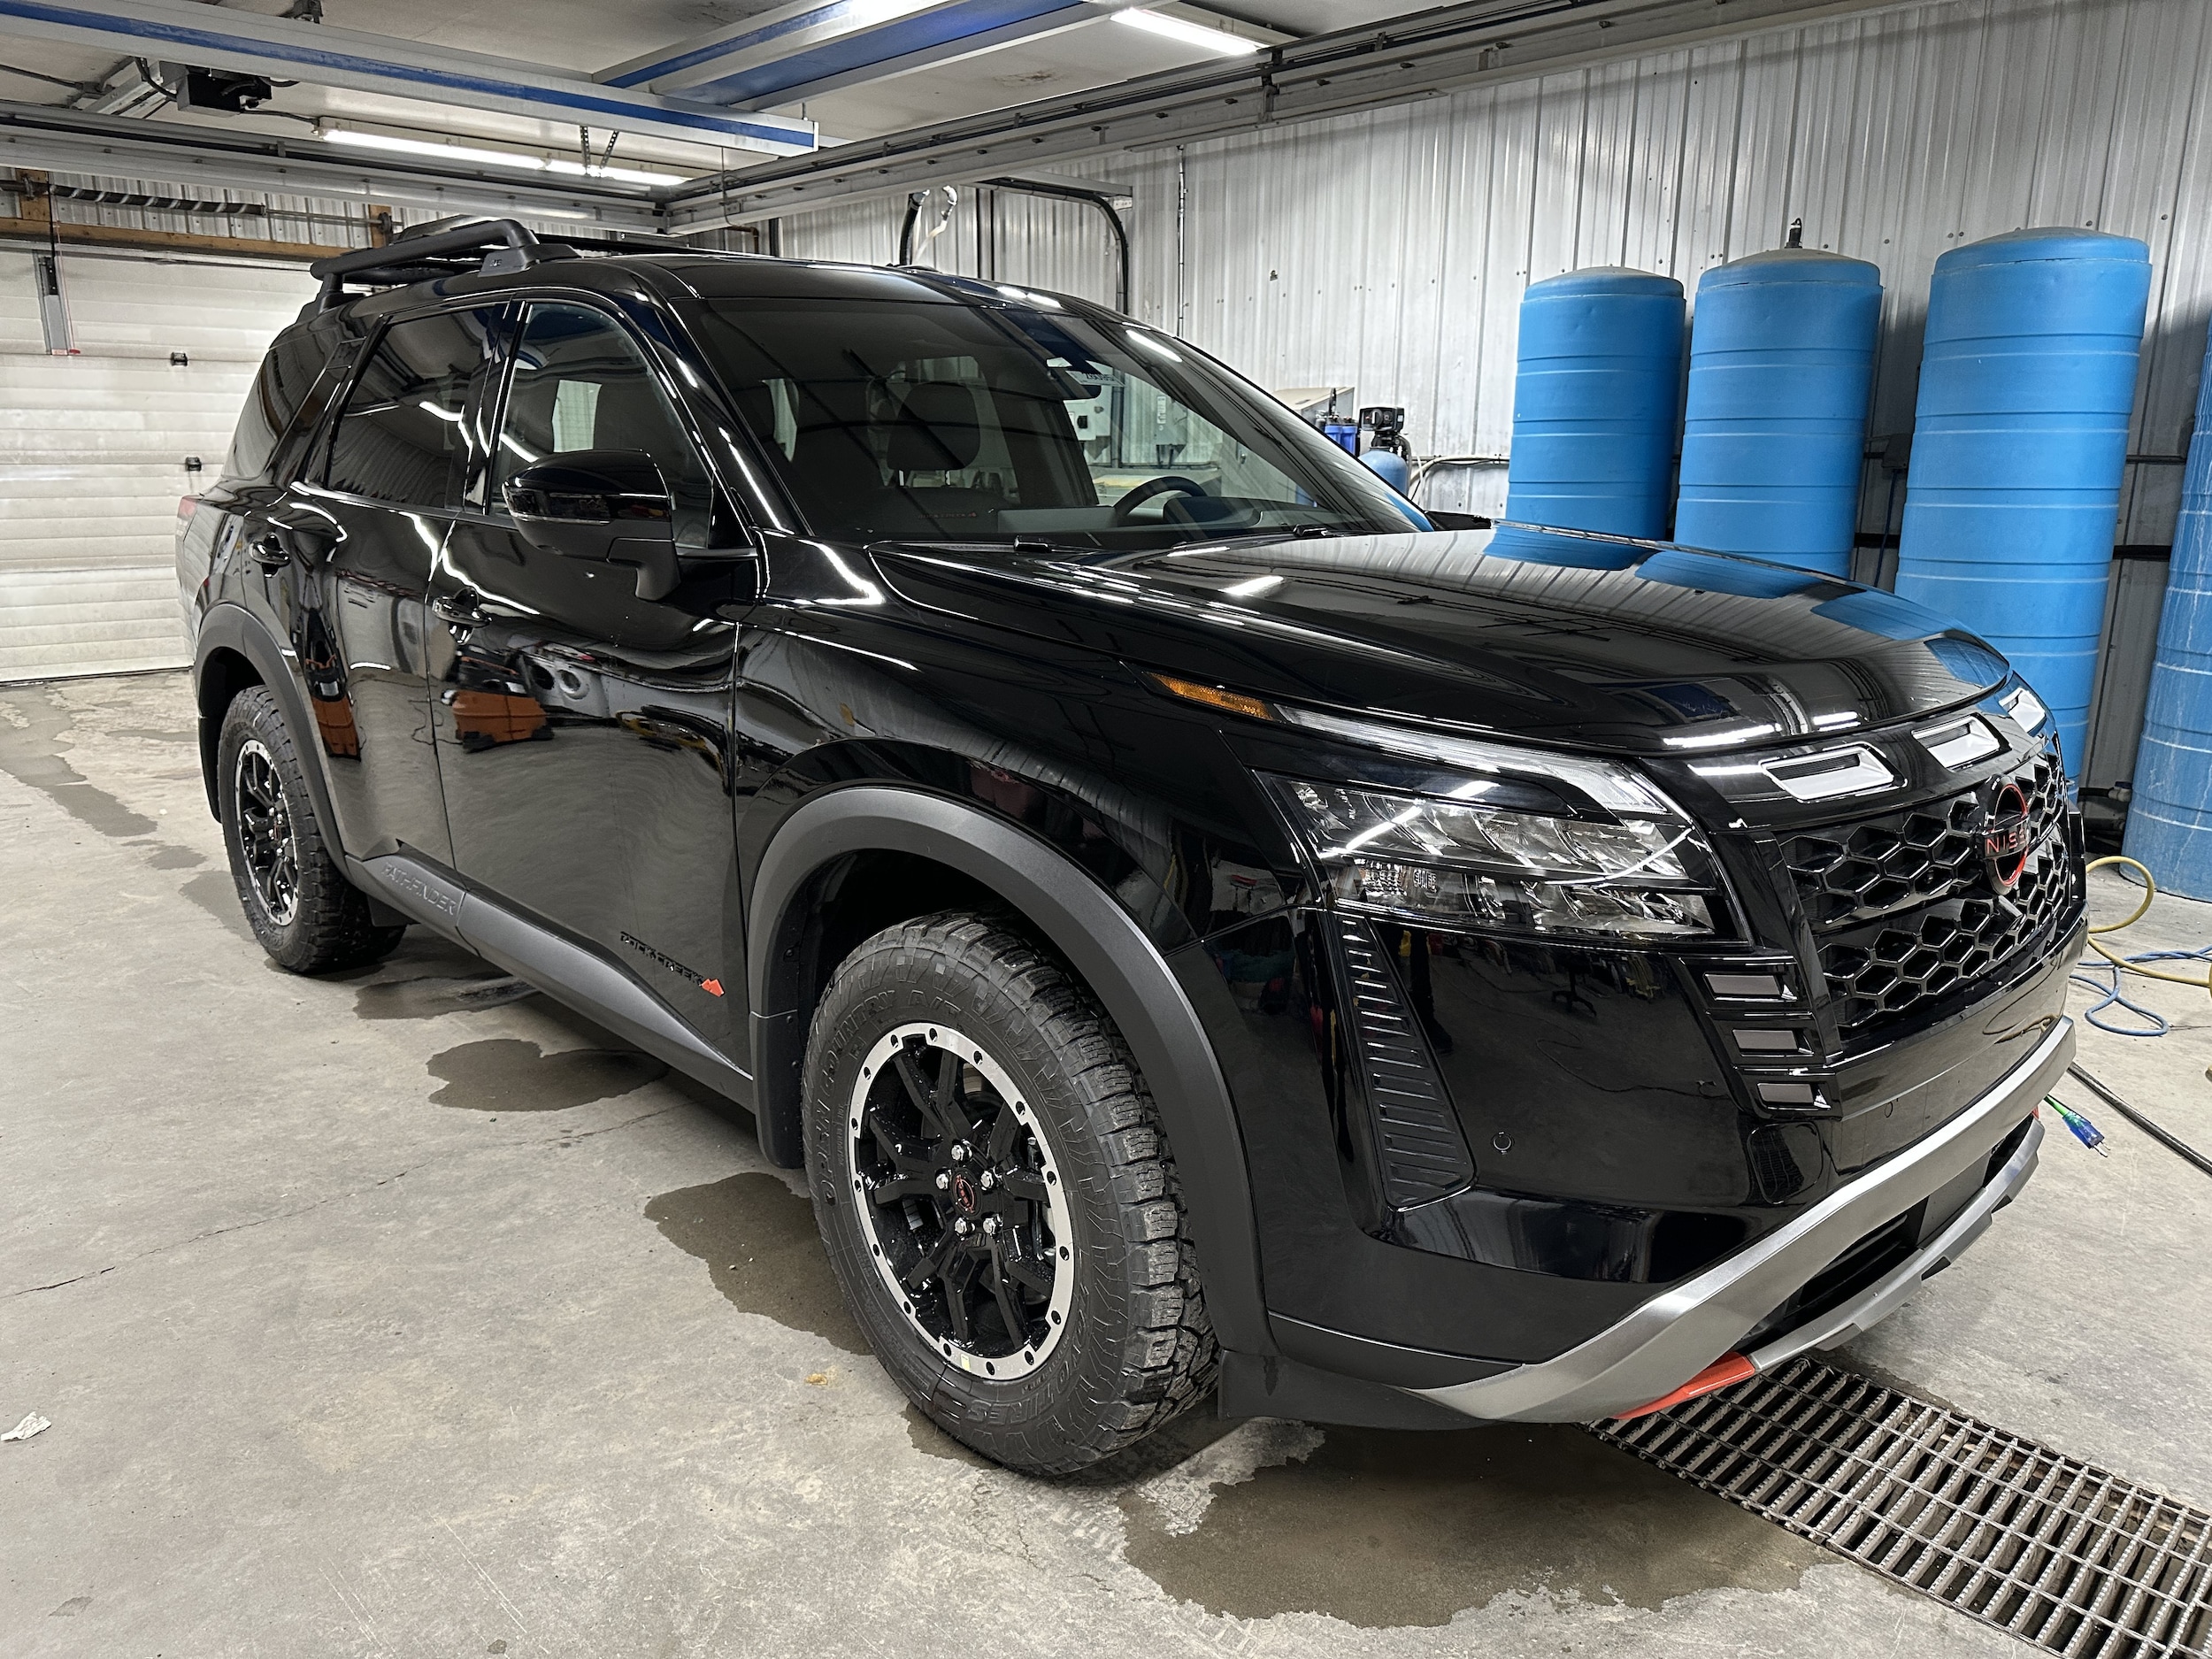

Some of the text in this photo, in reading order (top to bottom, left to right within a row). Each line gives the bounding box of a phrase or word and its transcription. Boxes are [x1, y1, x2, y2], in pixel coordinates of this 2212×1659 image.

[1985, 827, 2026, 855] NISS
[381, 862, 457, 916] PATHFINDER
[819, 988, 896, 1098] COUNTRY
